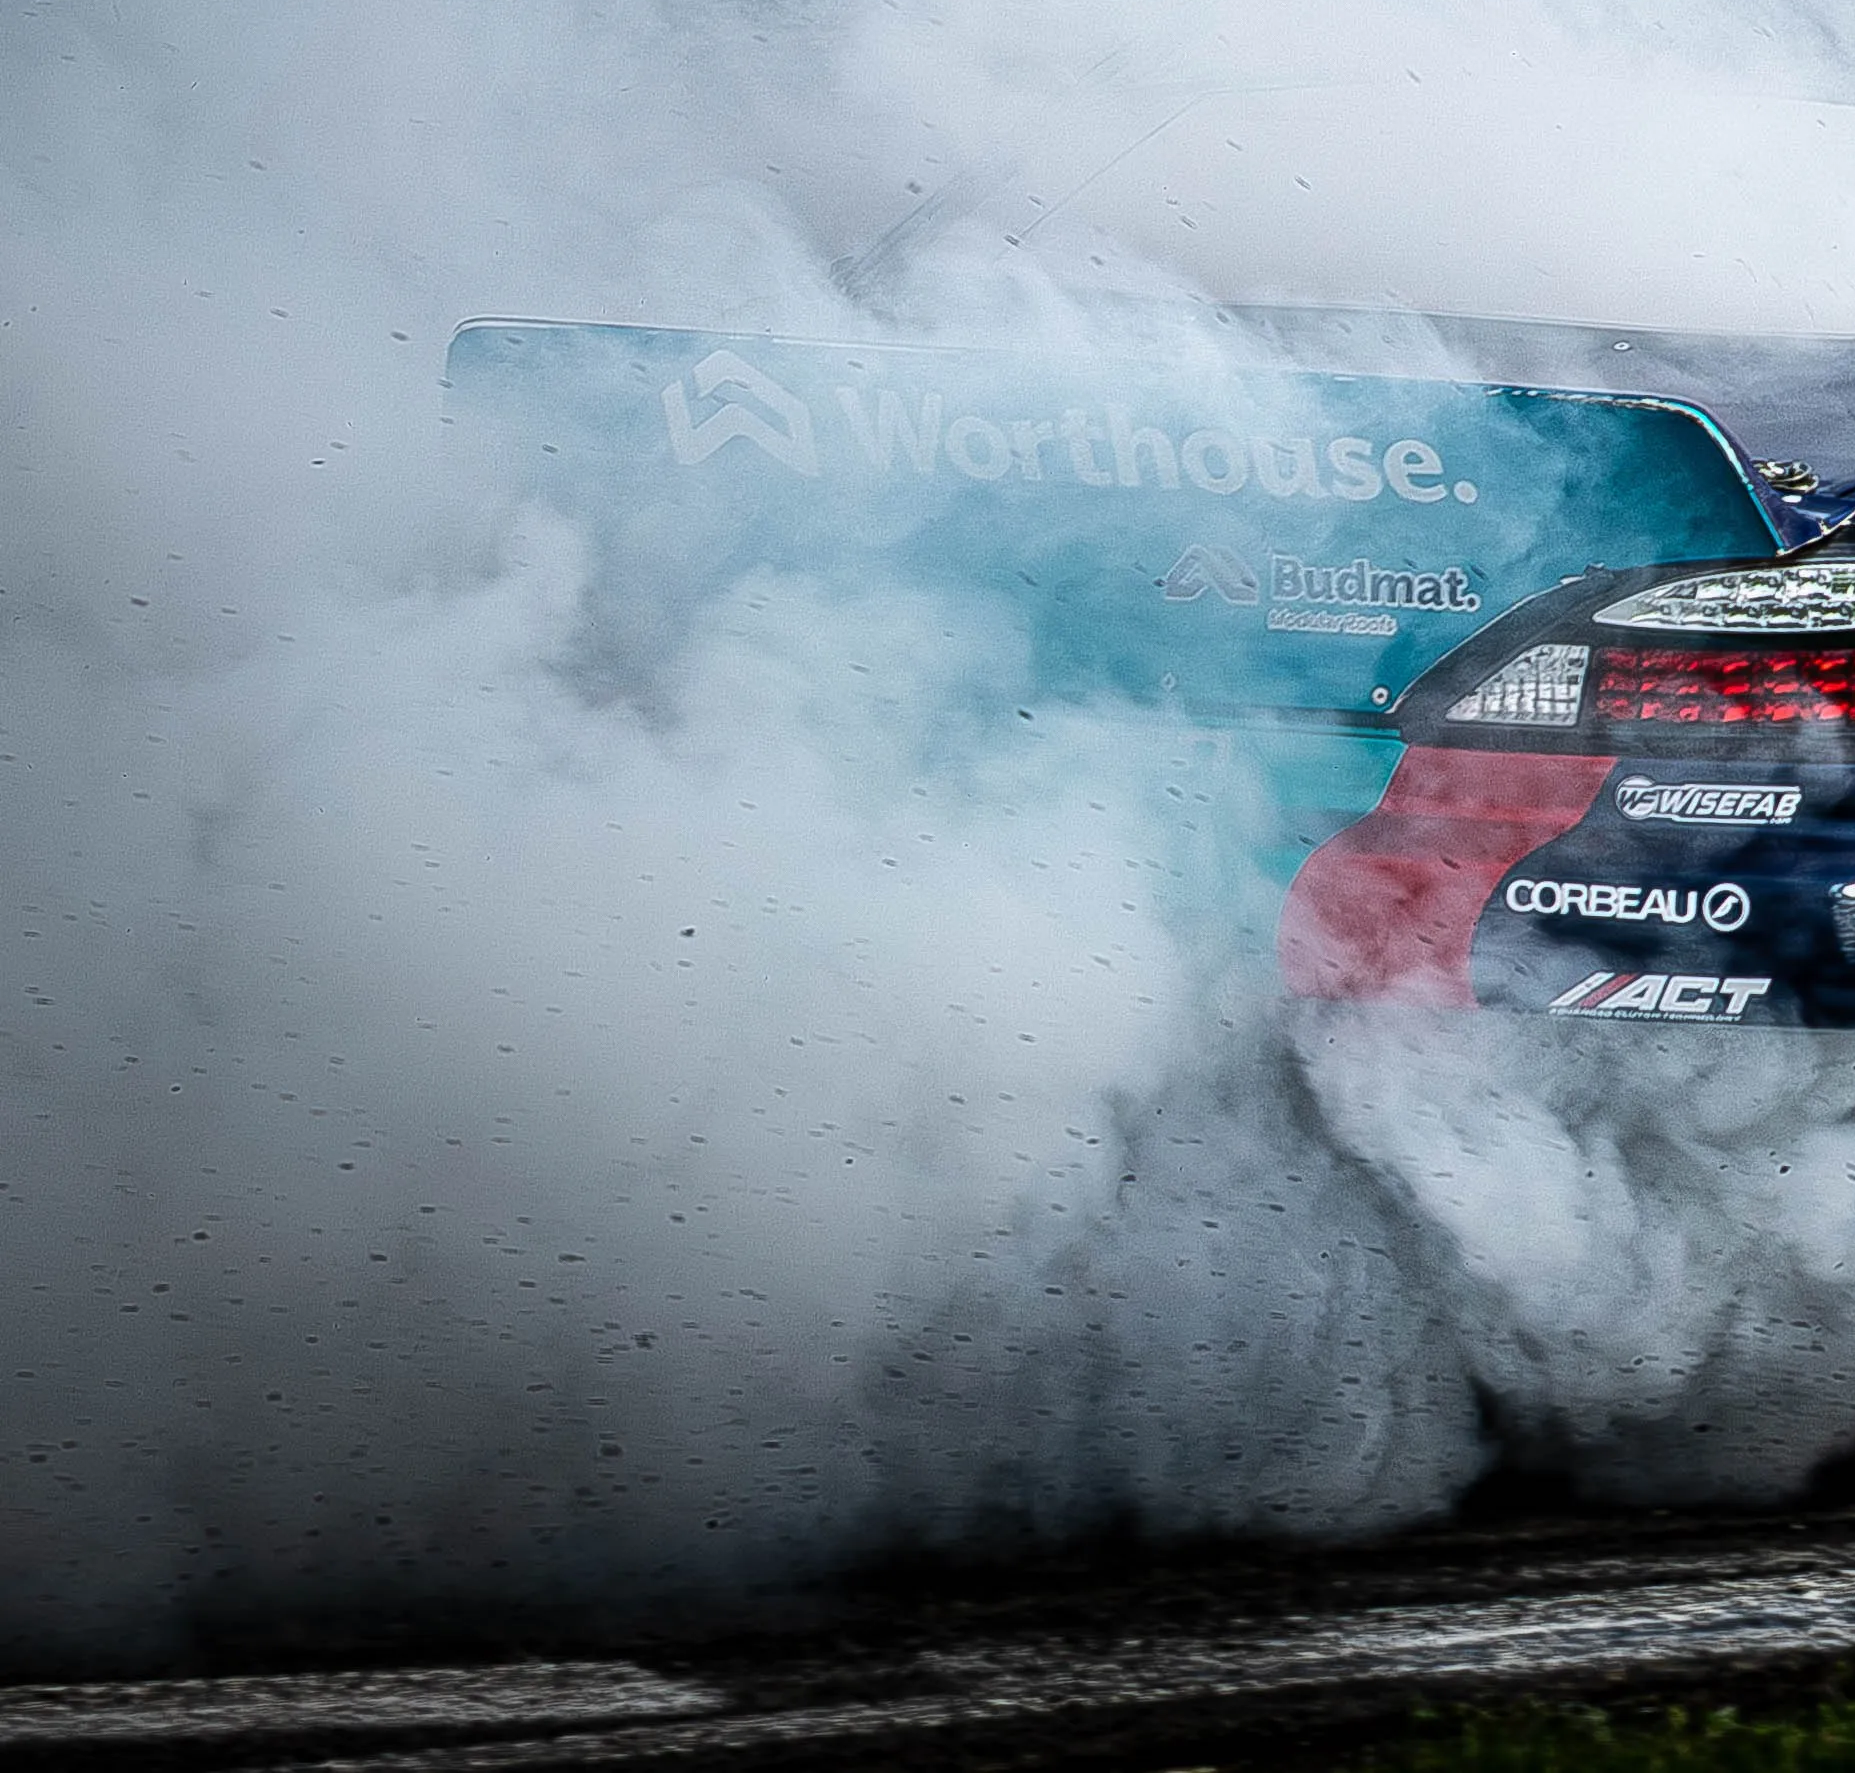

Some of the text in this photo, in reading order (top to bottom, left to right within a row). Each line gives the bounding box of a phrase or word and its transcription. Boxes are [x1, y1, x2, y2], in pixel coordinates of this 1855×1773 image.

[1660, 786, 1802, 818] WISEFAB
[1505, 878, 1698, 924] CORBEAU
[1599, 974, 1773, 1015] ACT
